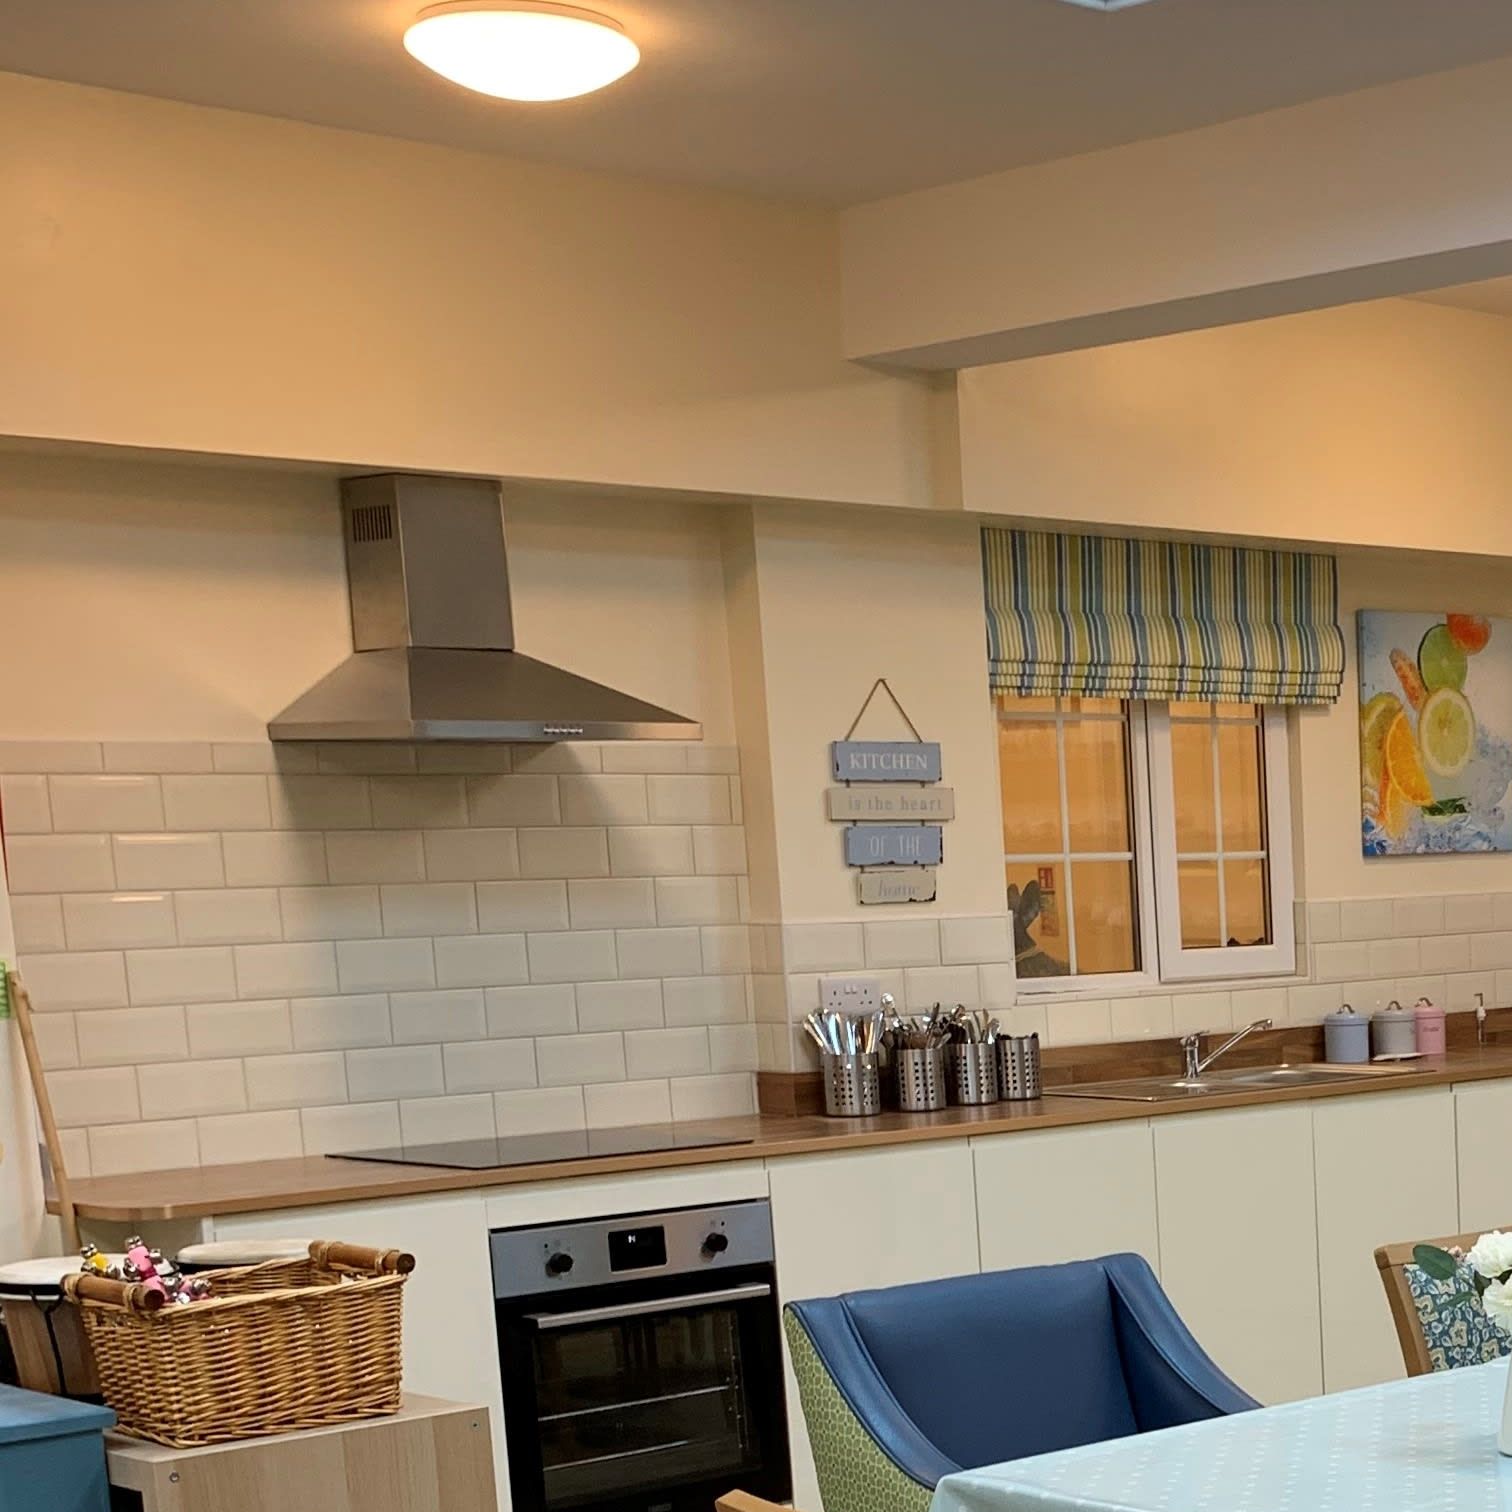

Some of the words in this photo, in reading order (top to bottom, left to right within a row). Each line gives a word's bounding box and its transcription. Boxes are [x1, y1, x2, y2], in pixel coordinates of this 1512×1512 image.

[849, 752, 928, 769] KITCHEN
[848, 796, 862, 811] is
[867, 796, 893, 811] the
[900, 795, 943, 811] heart
[870, 835, 886, 857] OF
[898, 835, 921, 857] THE
[878, 879, 920, 898] home
